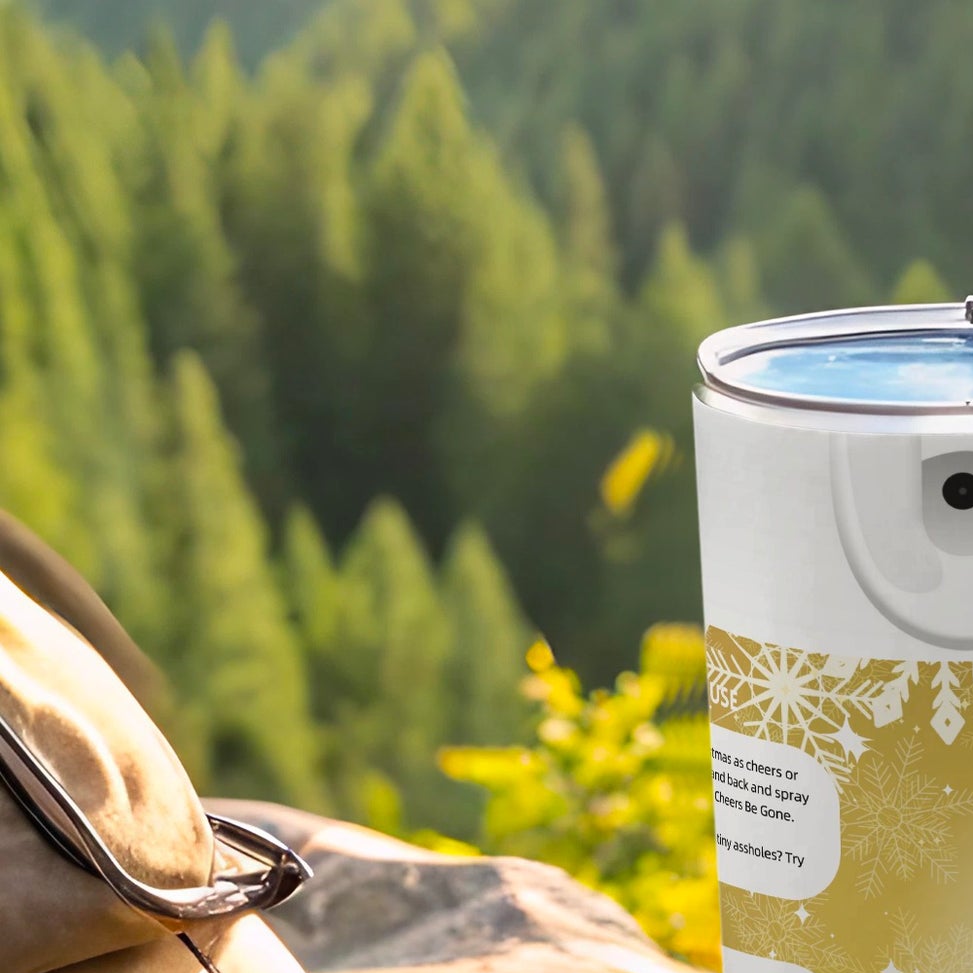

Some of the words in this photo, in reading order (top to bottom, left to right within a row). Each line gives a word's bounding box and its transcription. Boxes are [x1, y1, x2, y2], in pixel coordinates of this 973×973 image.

[733, 757, 744, 768] as
[746, 760, 782, 777] cheers
[785, 769, 799, 781] or
[727, 773, 749, 791] back
[750, 783, 772, 797] and
[774, 787, 810, 805] spray
[714, 790, 743, 810] Cheers
[745, 801, 758, 814] Be
[760, 806, 795, 822] Gone.
[716, 833, 732, 851] tiny
[733, 841, 783, 862] assholes?
[785, 851, 805, 867] Try
